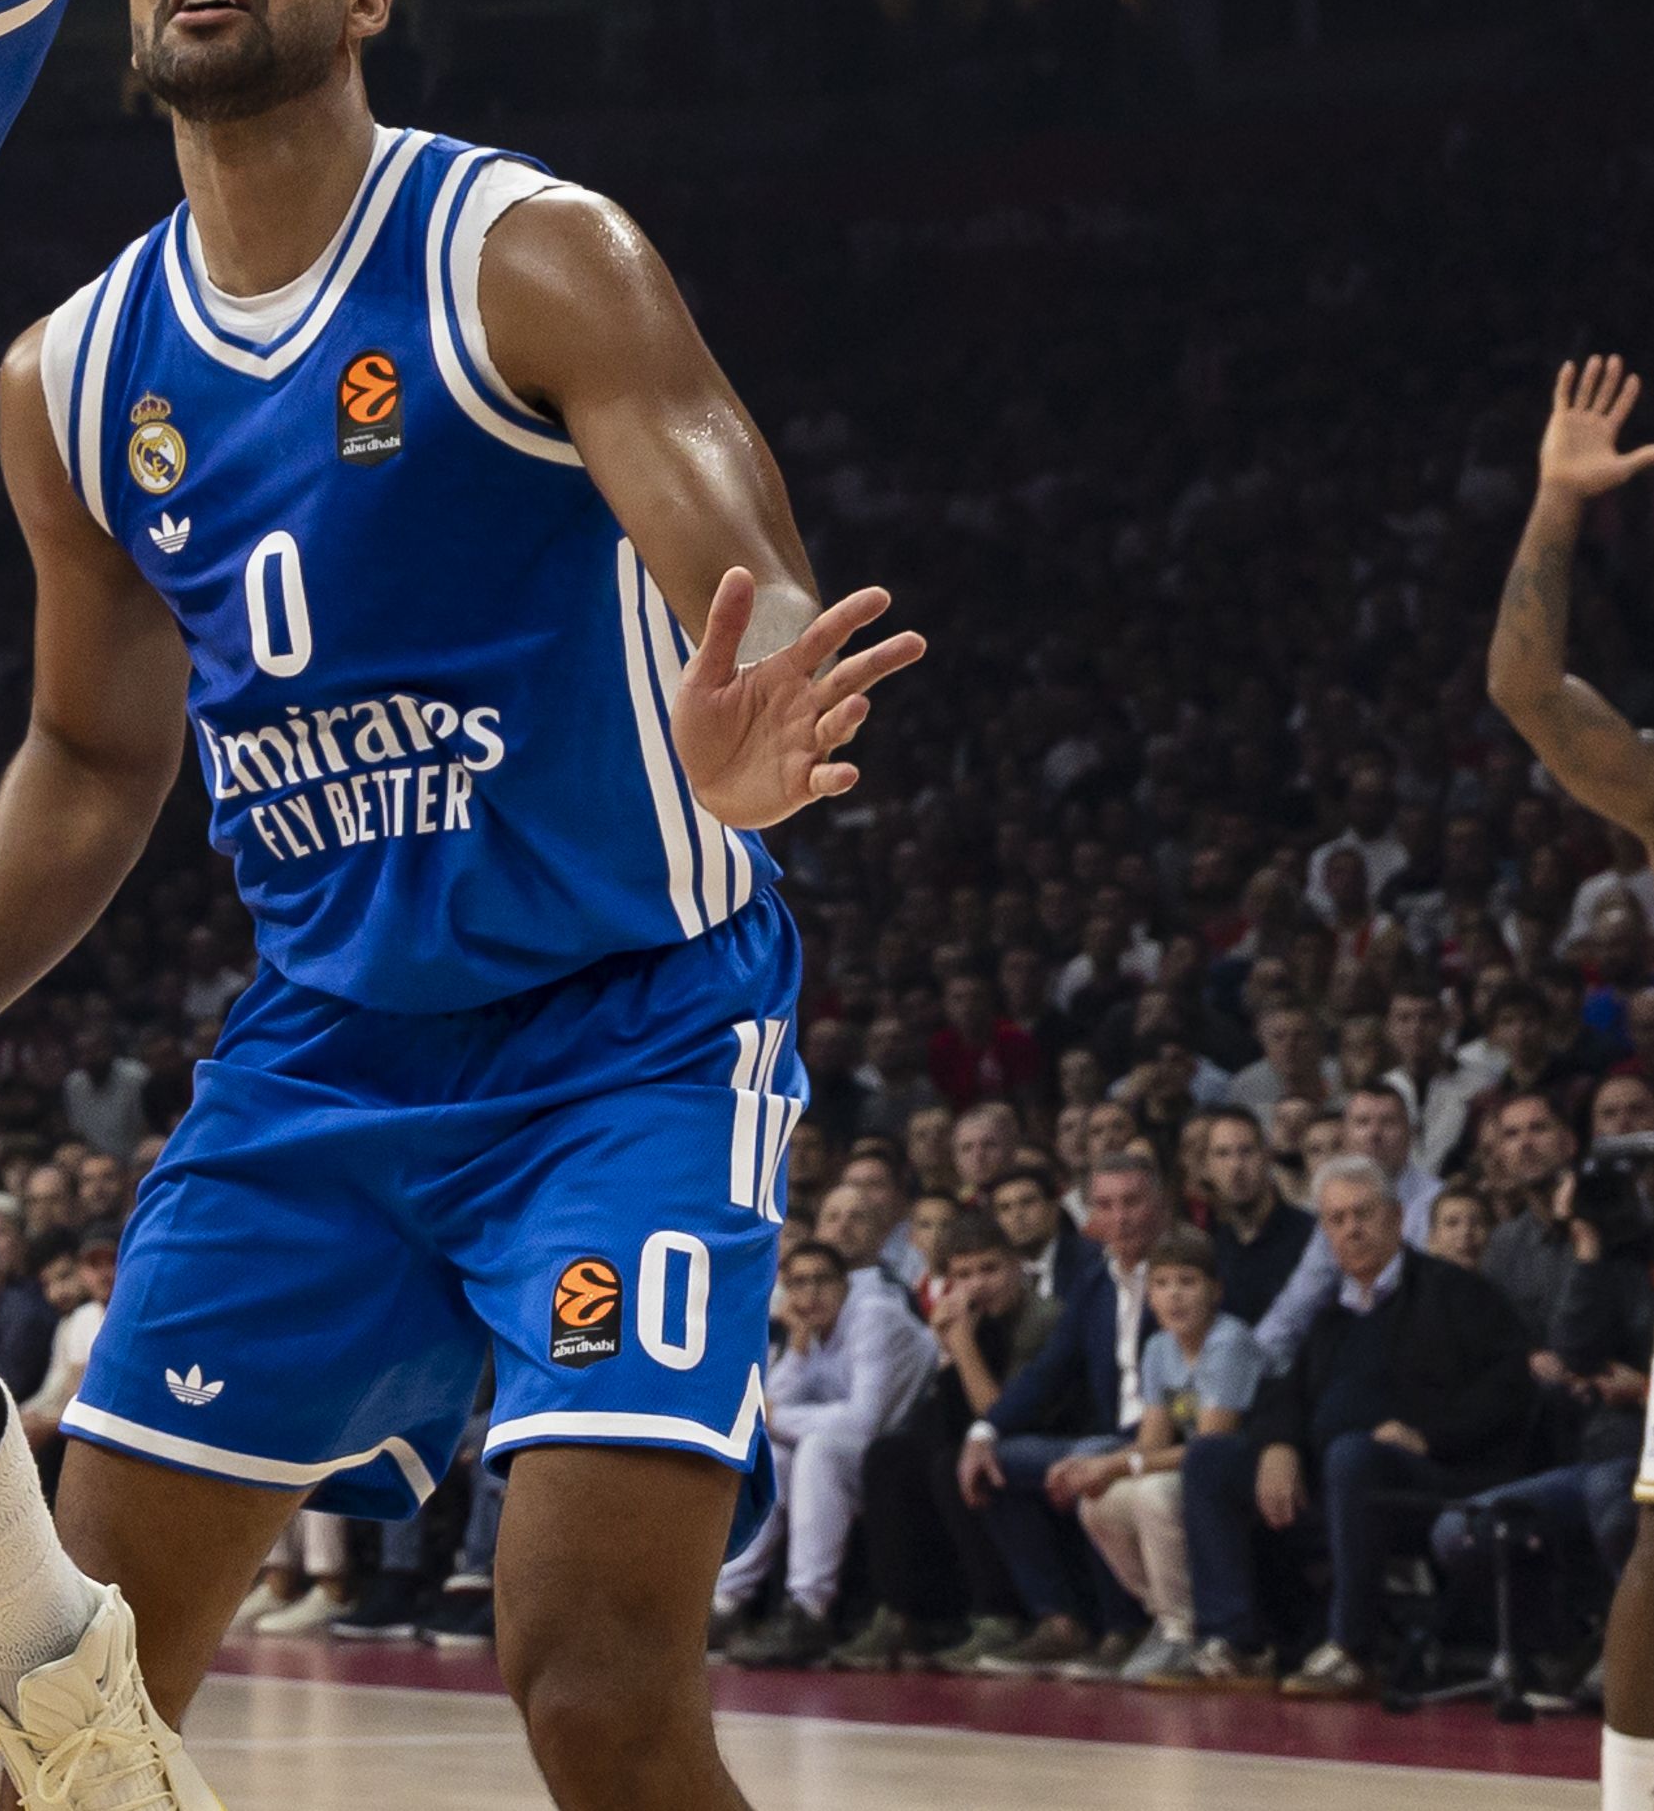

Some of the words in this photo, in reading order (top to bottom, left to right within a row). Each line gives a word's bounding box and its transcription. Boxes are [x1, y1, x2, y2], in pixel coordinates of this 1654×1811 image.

[245, 530, 313, 677] 0
[250, 793, 327, 861] FLY
[323, 763, 473, 848] BETTER
[552, 1344, 576, 1359] abu
[576, 1338, 616, 1354] dhabi
[637, 1231, 711, 1370] 0
